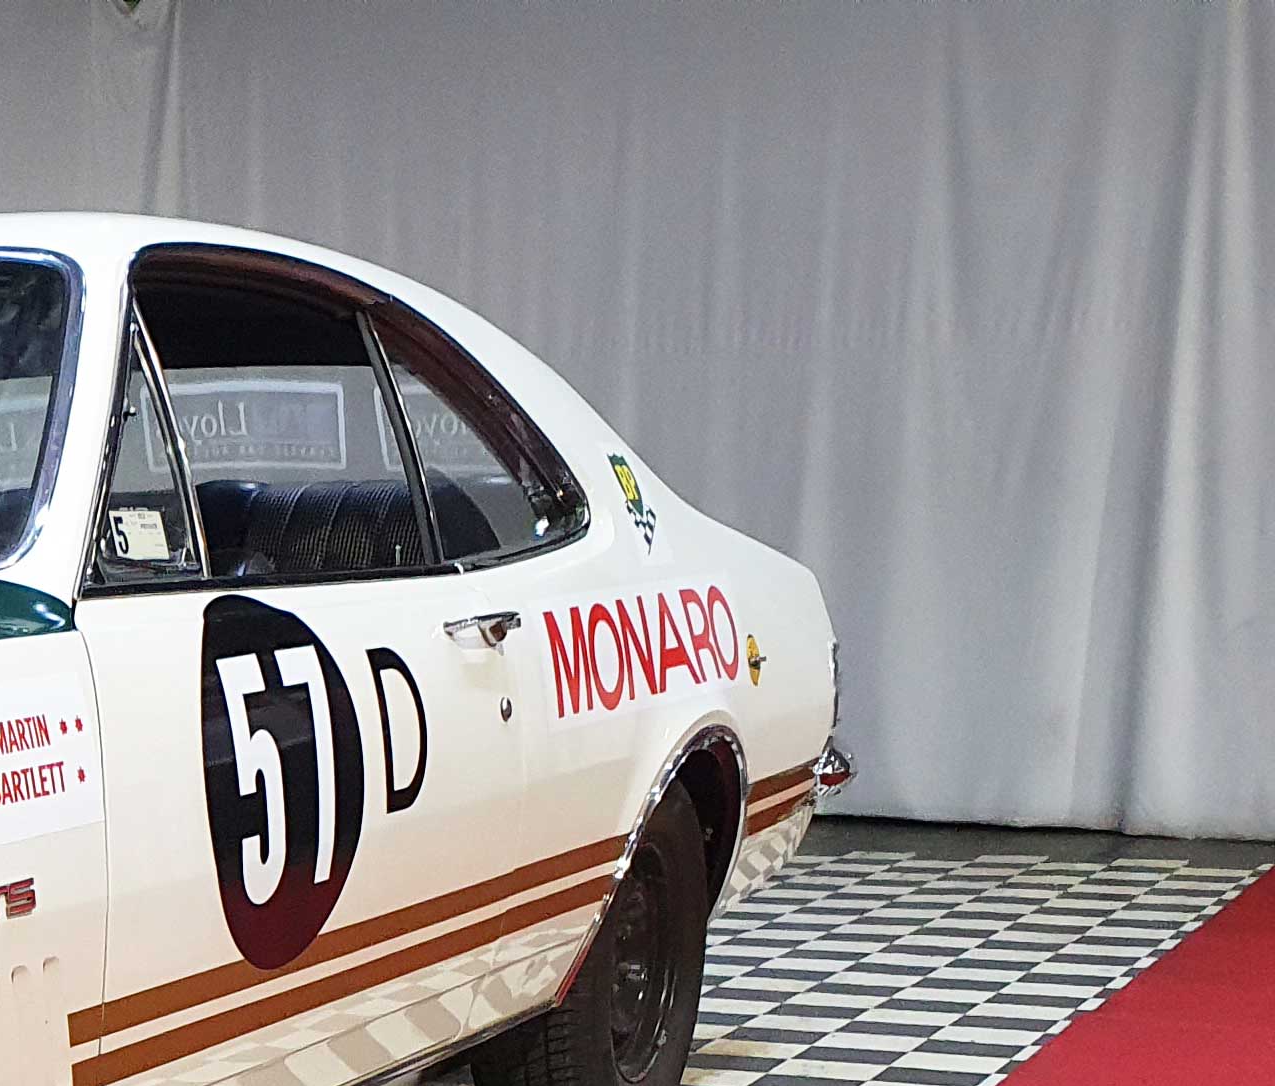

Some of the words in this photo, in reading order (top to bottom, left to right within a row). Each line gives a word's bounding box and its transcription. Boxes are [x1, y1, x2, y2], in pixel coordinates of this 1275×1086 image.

[543, 585, 739, 718] MONARO
[215, 644, 336, 905] 57
[365, 647, 428, 814] D
